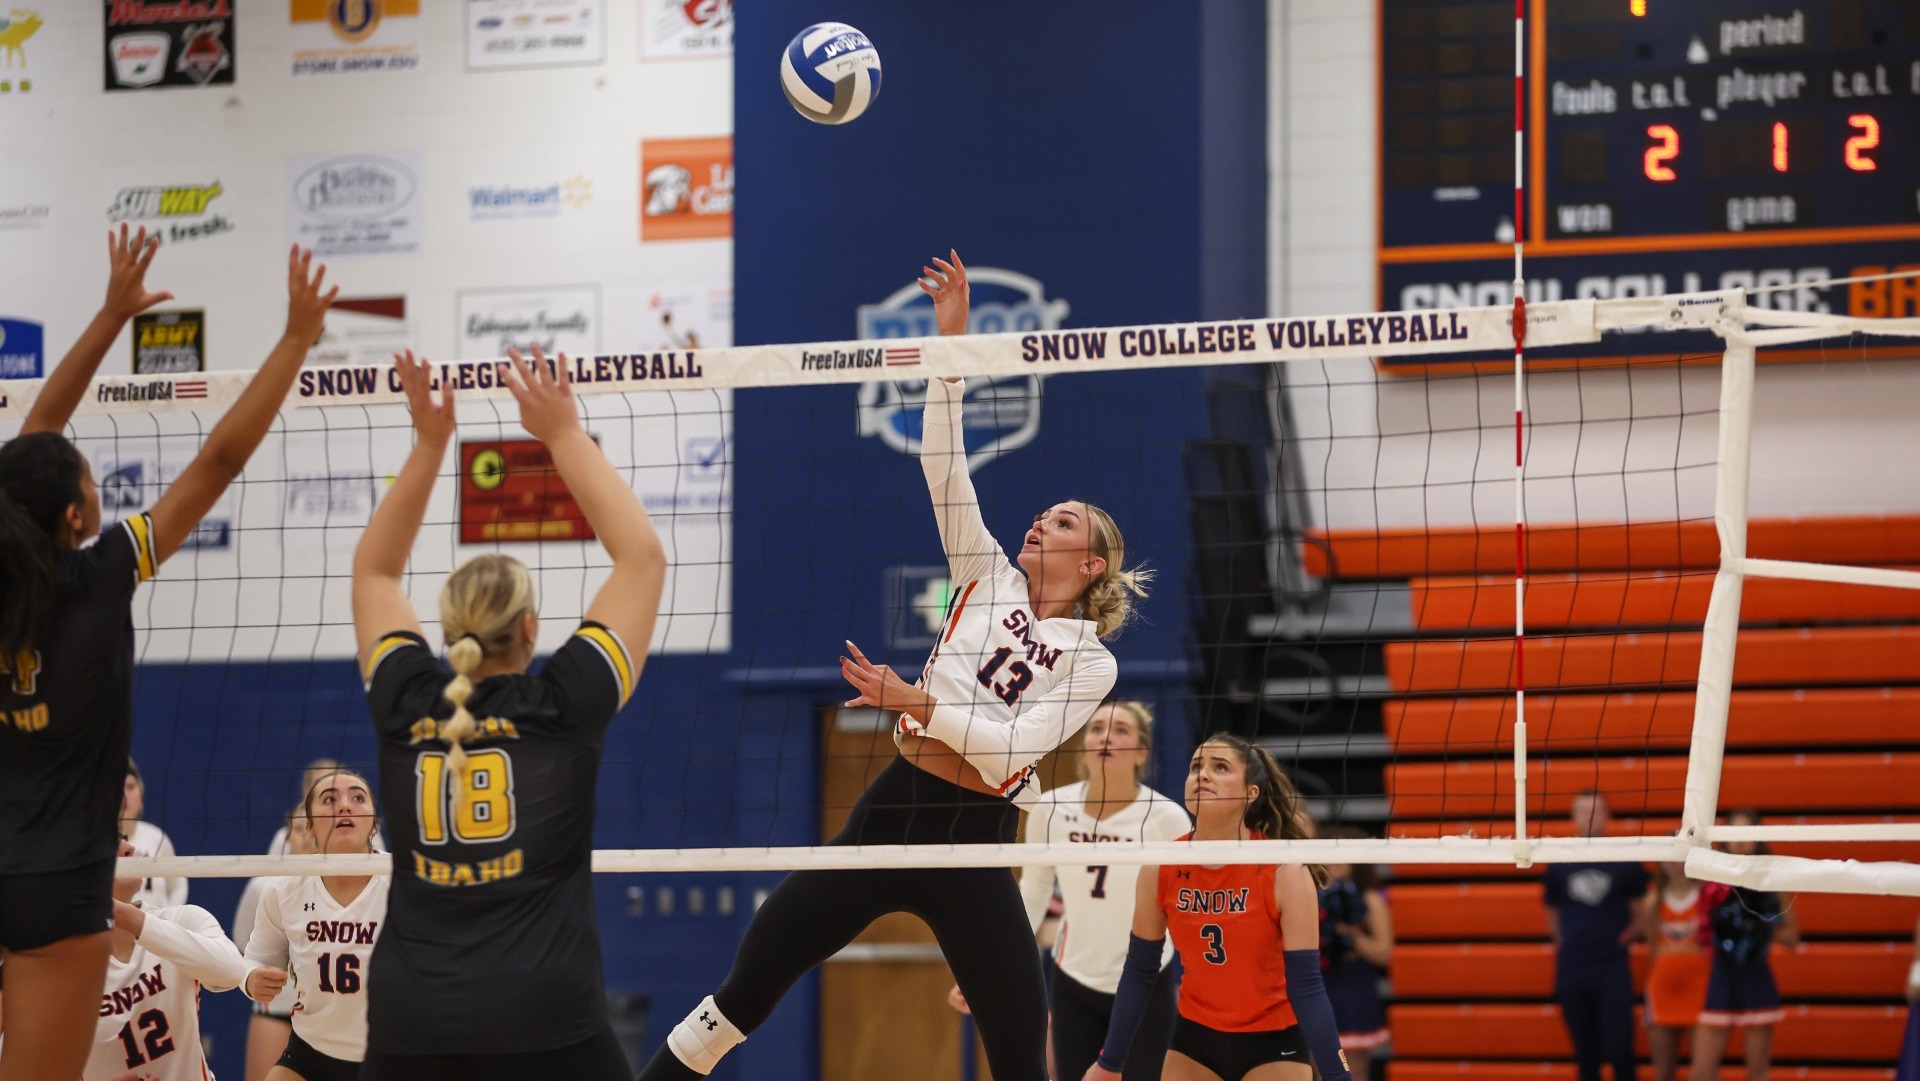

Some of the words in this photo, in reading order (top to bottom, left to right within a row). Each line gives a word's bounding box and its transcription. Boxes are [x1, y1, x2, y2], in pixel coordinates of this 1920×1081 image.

[1720, 9, 1804, 55] period
[1552, 79, 1617, 116] fouls
[1717, 67, 1807, 109] player
[1644, 125, 1680, 181] 2
[1773, 121, 1789, 172] 1
[1845, 114, 1880, 171] 2
[107, 179, 223, 222] SUBWAY
[469, 182, 560, 207] Walmart
[1557, 203, 1612, 233] won
[1727, 195, 1796, 232] game
[140, 323, 198, 348] ARMY
[1021, 331, 1107, 363] SNOW
[1119, 324, 1256, 358] COLLEGE
[1267, 312, 1468, 350] VOLLEYBALL
[300, 367, 378, 397] SNOW
[388, 362, 511, 392] CLEGE
[525, 352, 703, 383] LEYBALL
[801, 348, 883, 371] FreeTaxUSA
[98, 381, 173, 402] FreeTaxUSA
[976, 646, 1034, 708] 13
[415, 748, 517, 845] 18
[411, 848, 524, 887] IDAHO
[1086, 865, 1109, 899] 7
[1176, 888, 1249, 914] SNOW
[306, 920, 378, 945] SNOW
[1200, 923, 1228, 966] 3
[317, 952, 361, 994] 16
[118, 1008, 175, 1071] 12
